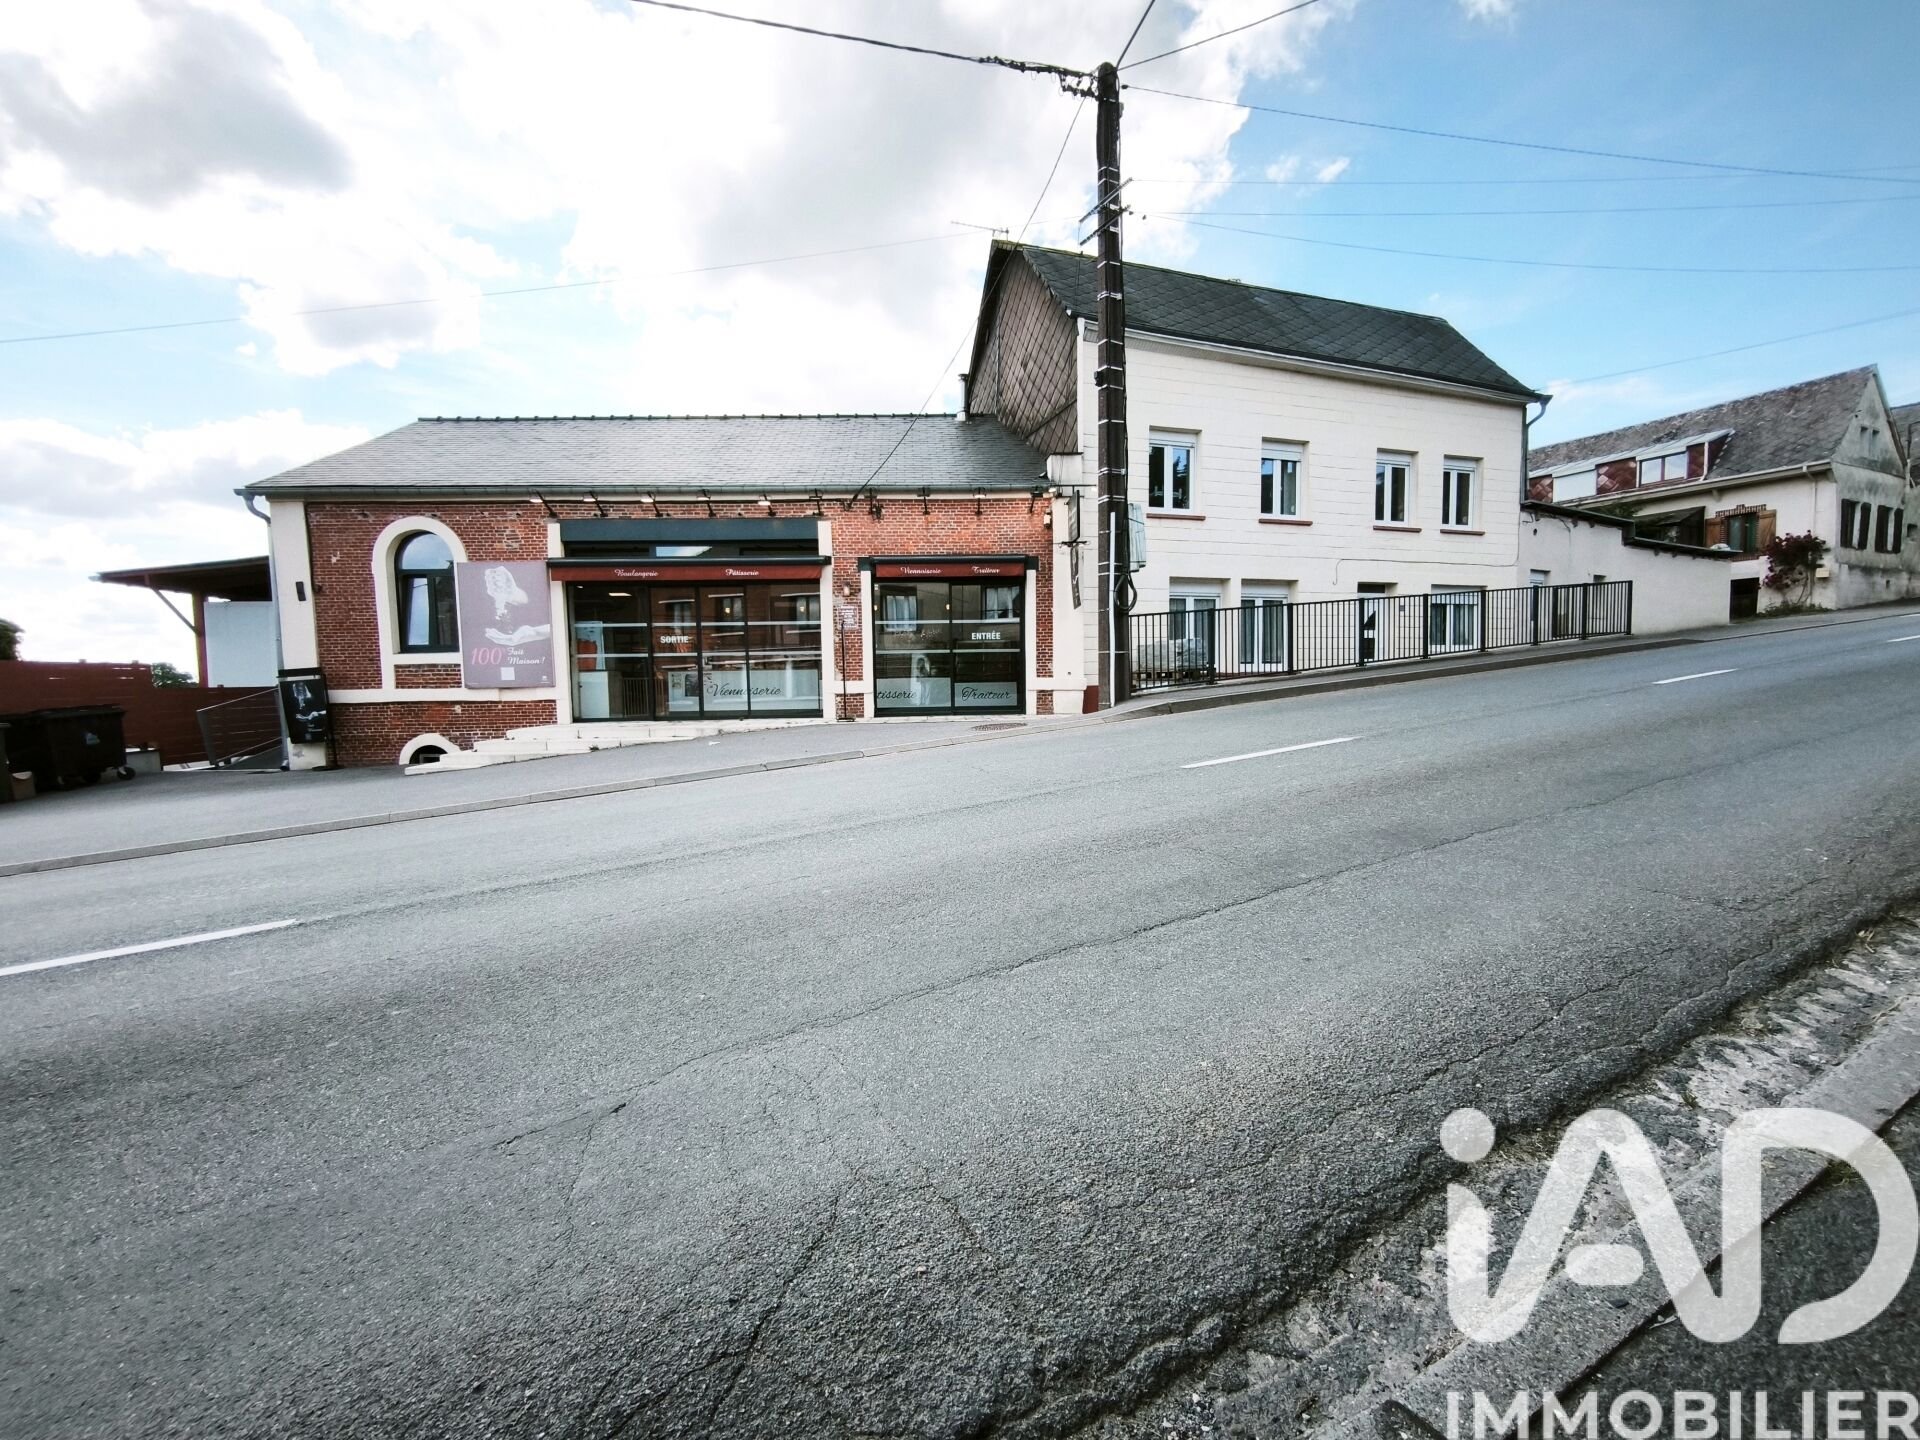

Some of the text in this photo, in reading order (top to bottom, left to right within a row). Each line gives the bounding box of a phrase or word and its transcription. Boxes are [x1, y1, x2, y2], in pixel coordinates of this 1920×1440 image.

[614, 569, 658, 578] Boulangerie
[725, 568, 759, 576] Pâtisserie
[660, 635, 689, 644] SORTIE
[971, 630, 1001, 640] ENTRÉE
[507, 647, 525, 655] Fait
[471, 647, 502, 665] 100
[961, 687, 1011, 701] Traiteur
